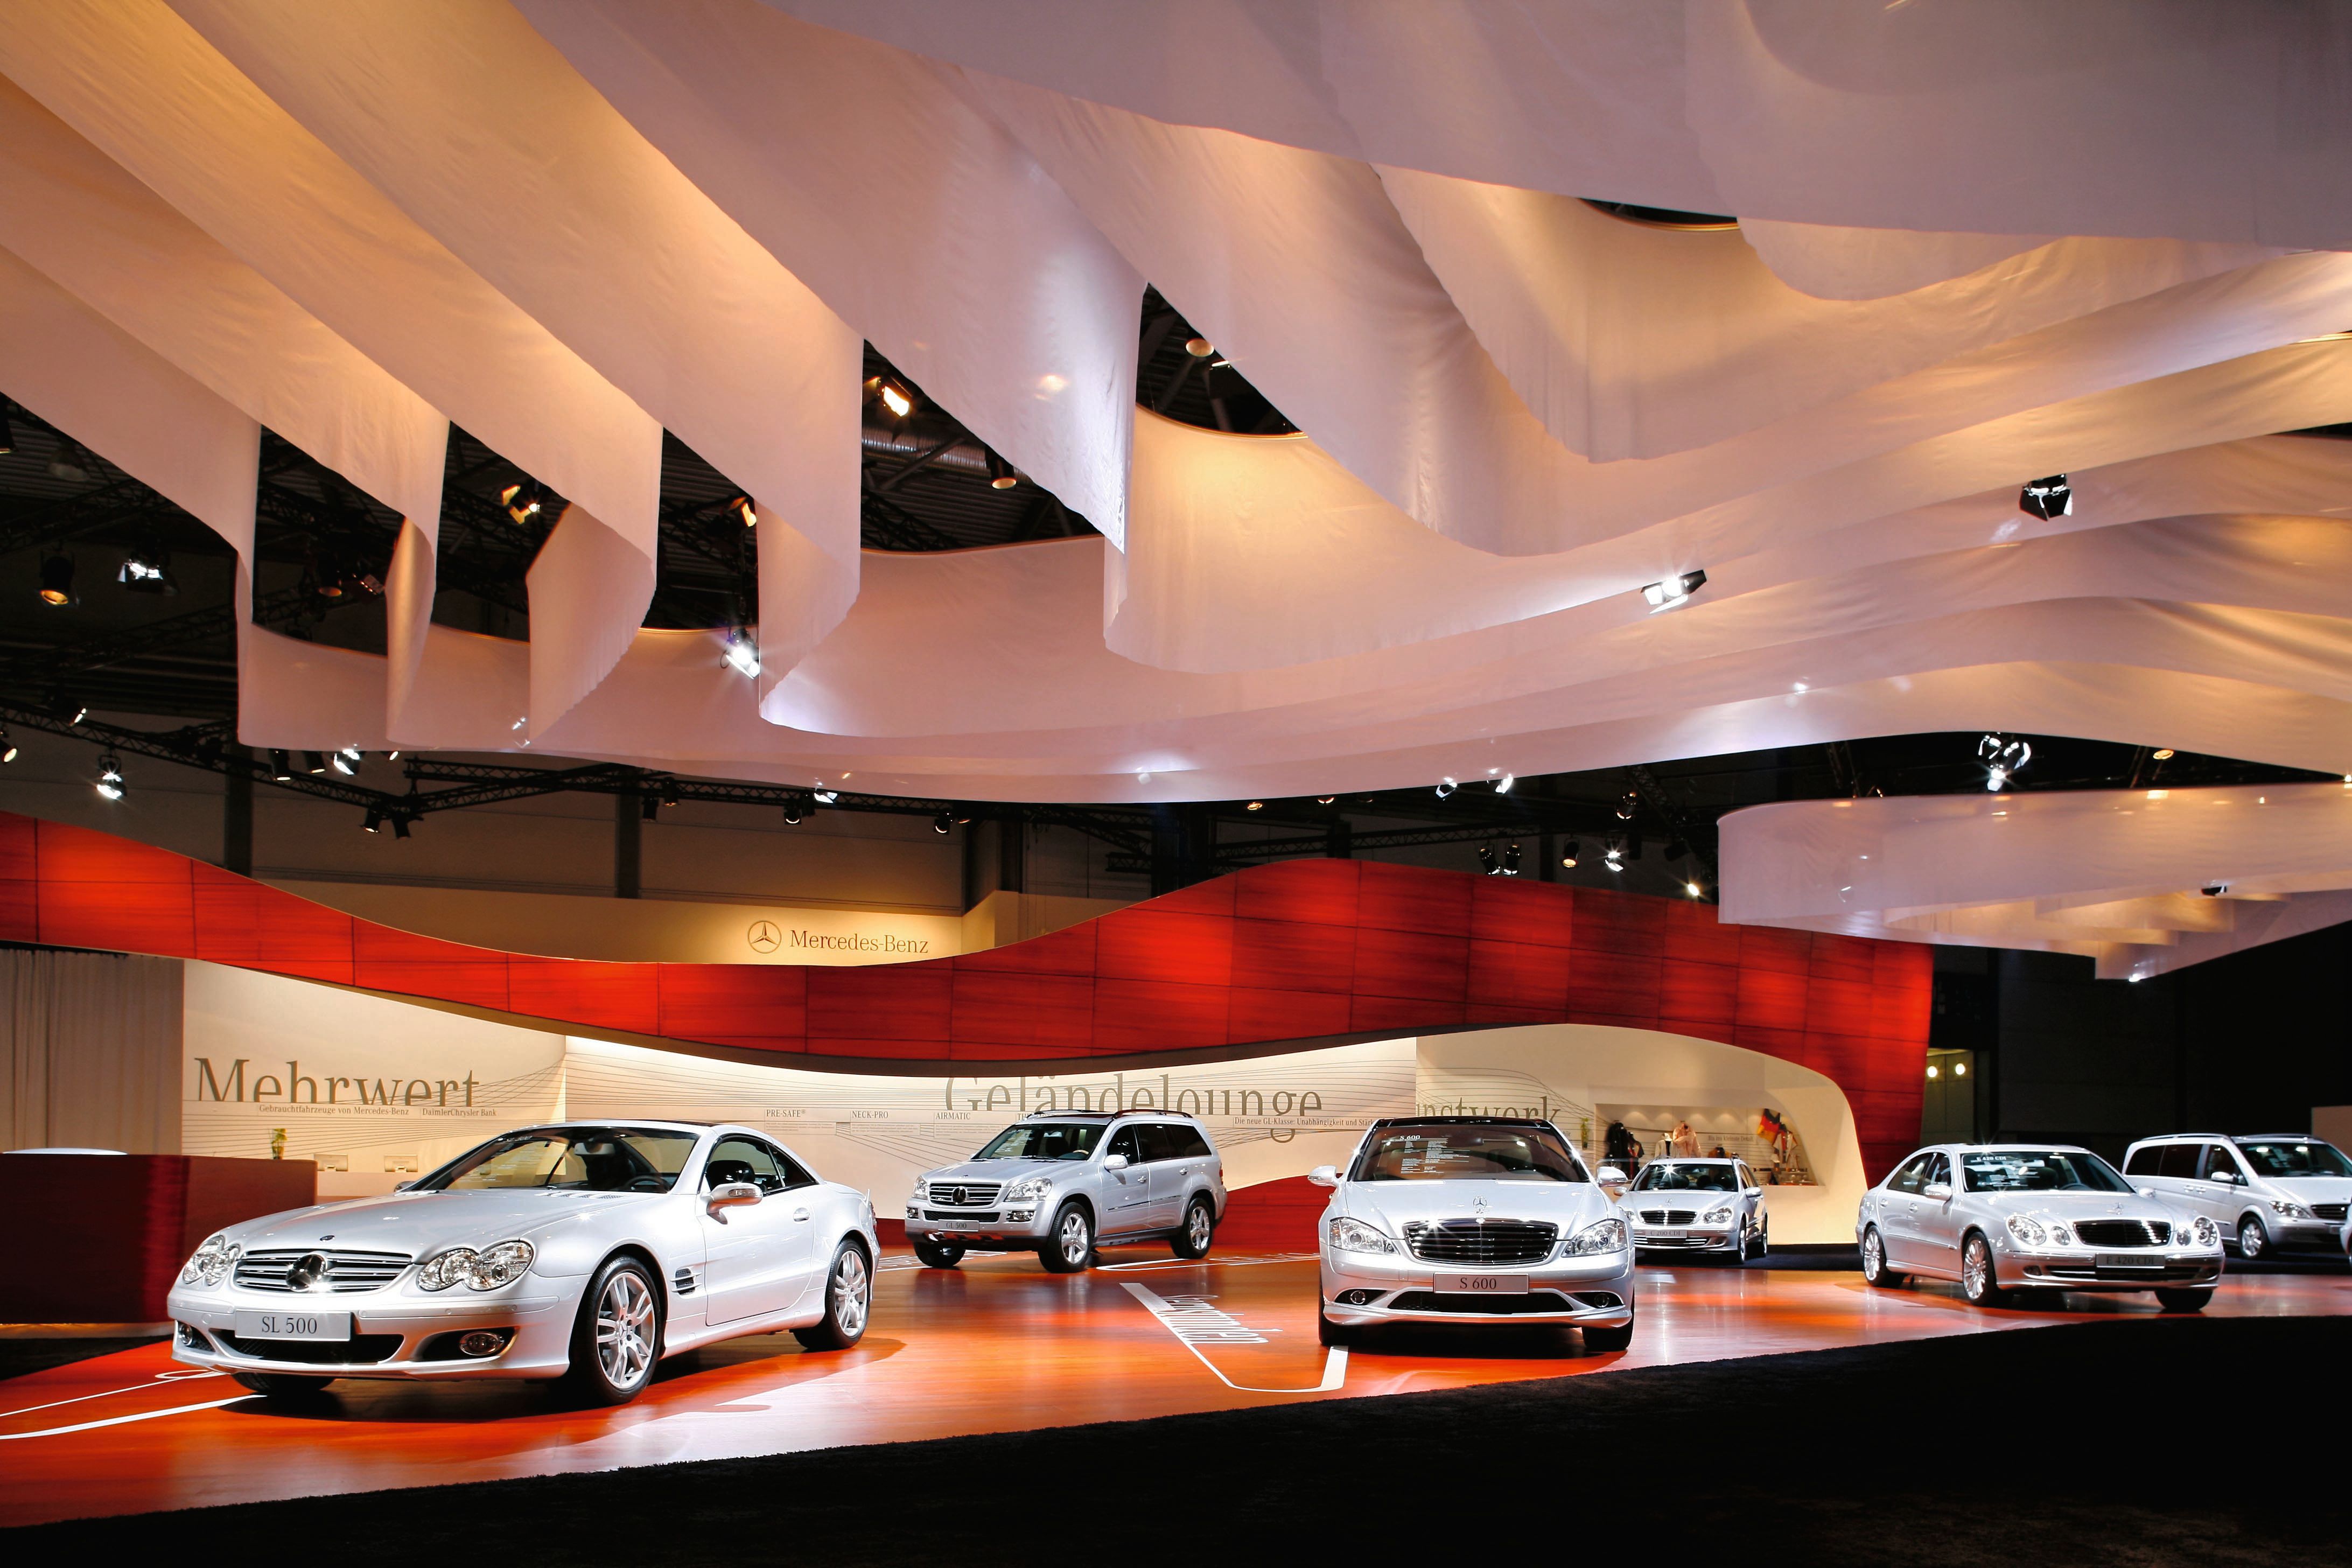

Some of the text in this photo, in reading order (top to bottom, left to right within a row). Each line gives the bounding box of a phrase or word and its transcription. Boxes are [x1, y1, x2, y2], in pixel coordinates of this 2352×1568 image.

[789, 929, 929, 954] Mercedes-Benz
[194, 1058, 479, 1107] Mehrwert
[259, 1104, 335, 1115] Gebrauchtfahrzeuge
[354, 1107, 409, 1115] Mercedes-Benz
[422, 1108, 479, 1118] DaimlerChrysler
[851, 1110, 889, 1119] NECK-PRO
[935, 1112, 971, 1120] AIRMATIC
[1297, 1117, 1344, 1127] Unabhängigkeit
[2115, 1256, 2134, 1265] 420
[2136, 1256, 2154, 1265] CDI
[1460, 1277, 1497, 1290] S 600
[261, 1316, 317, 1334] SL 500
